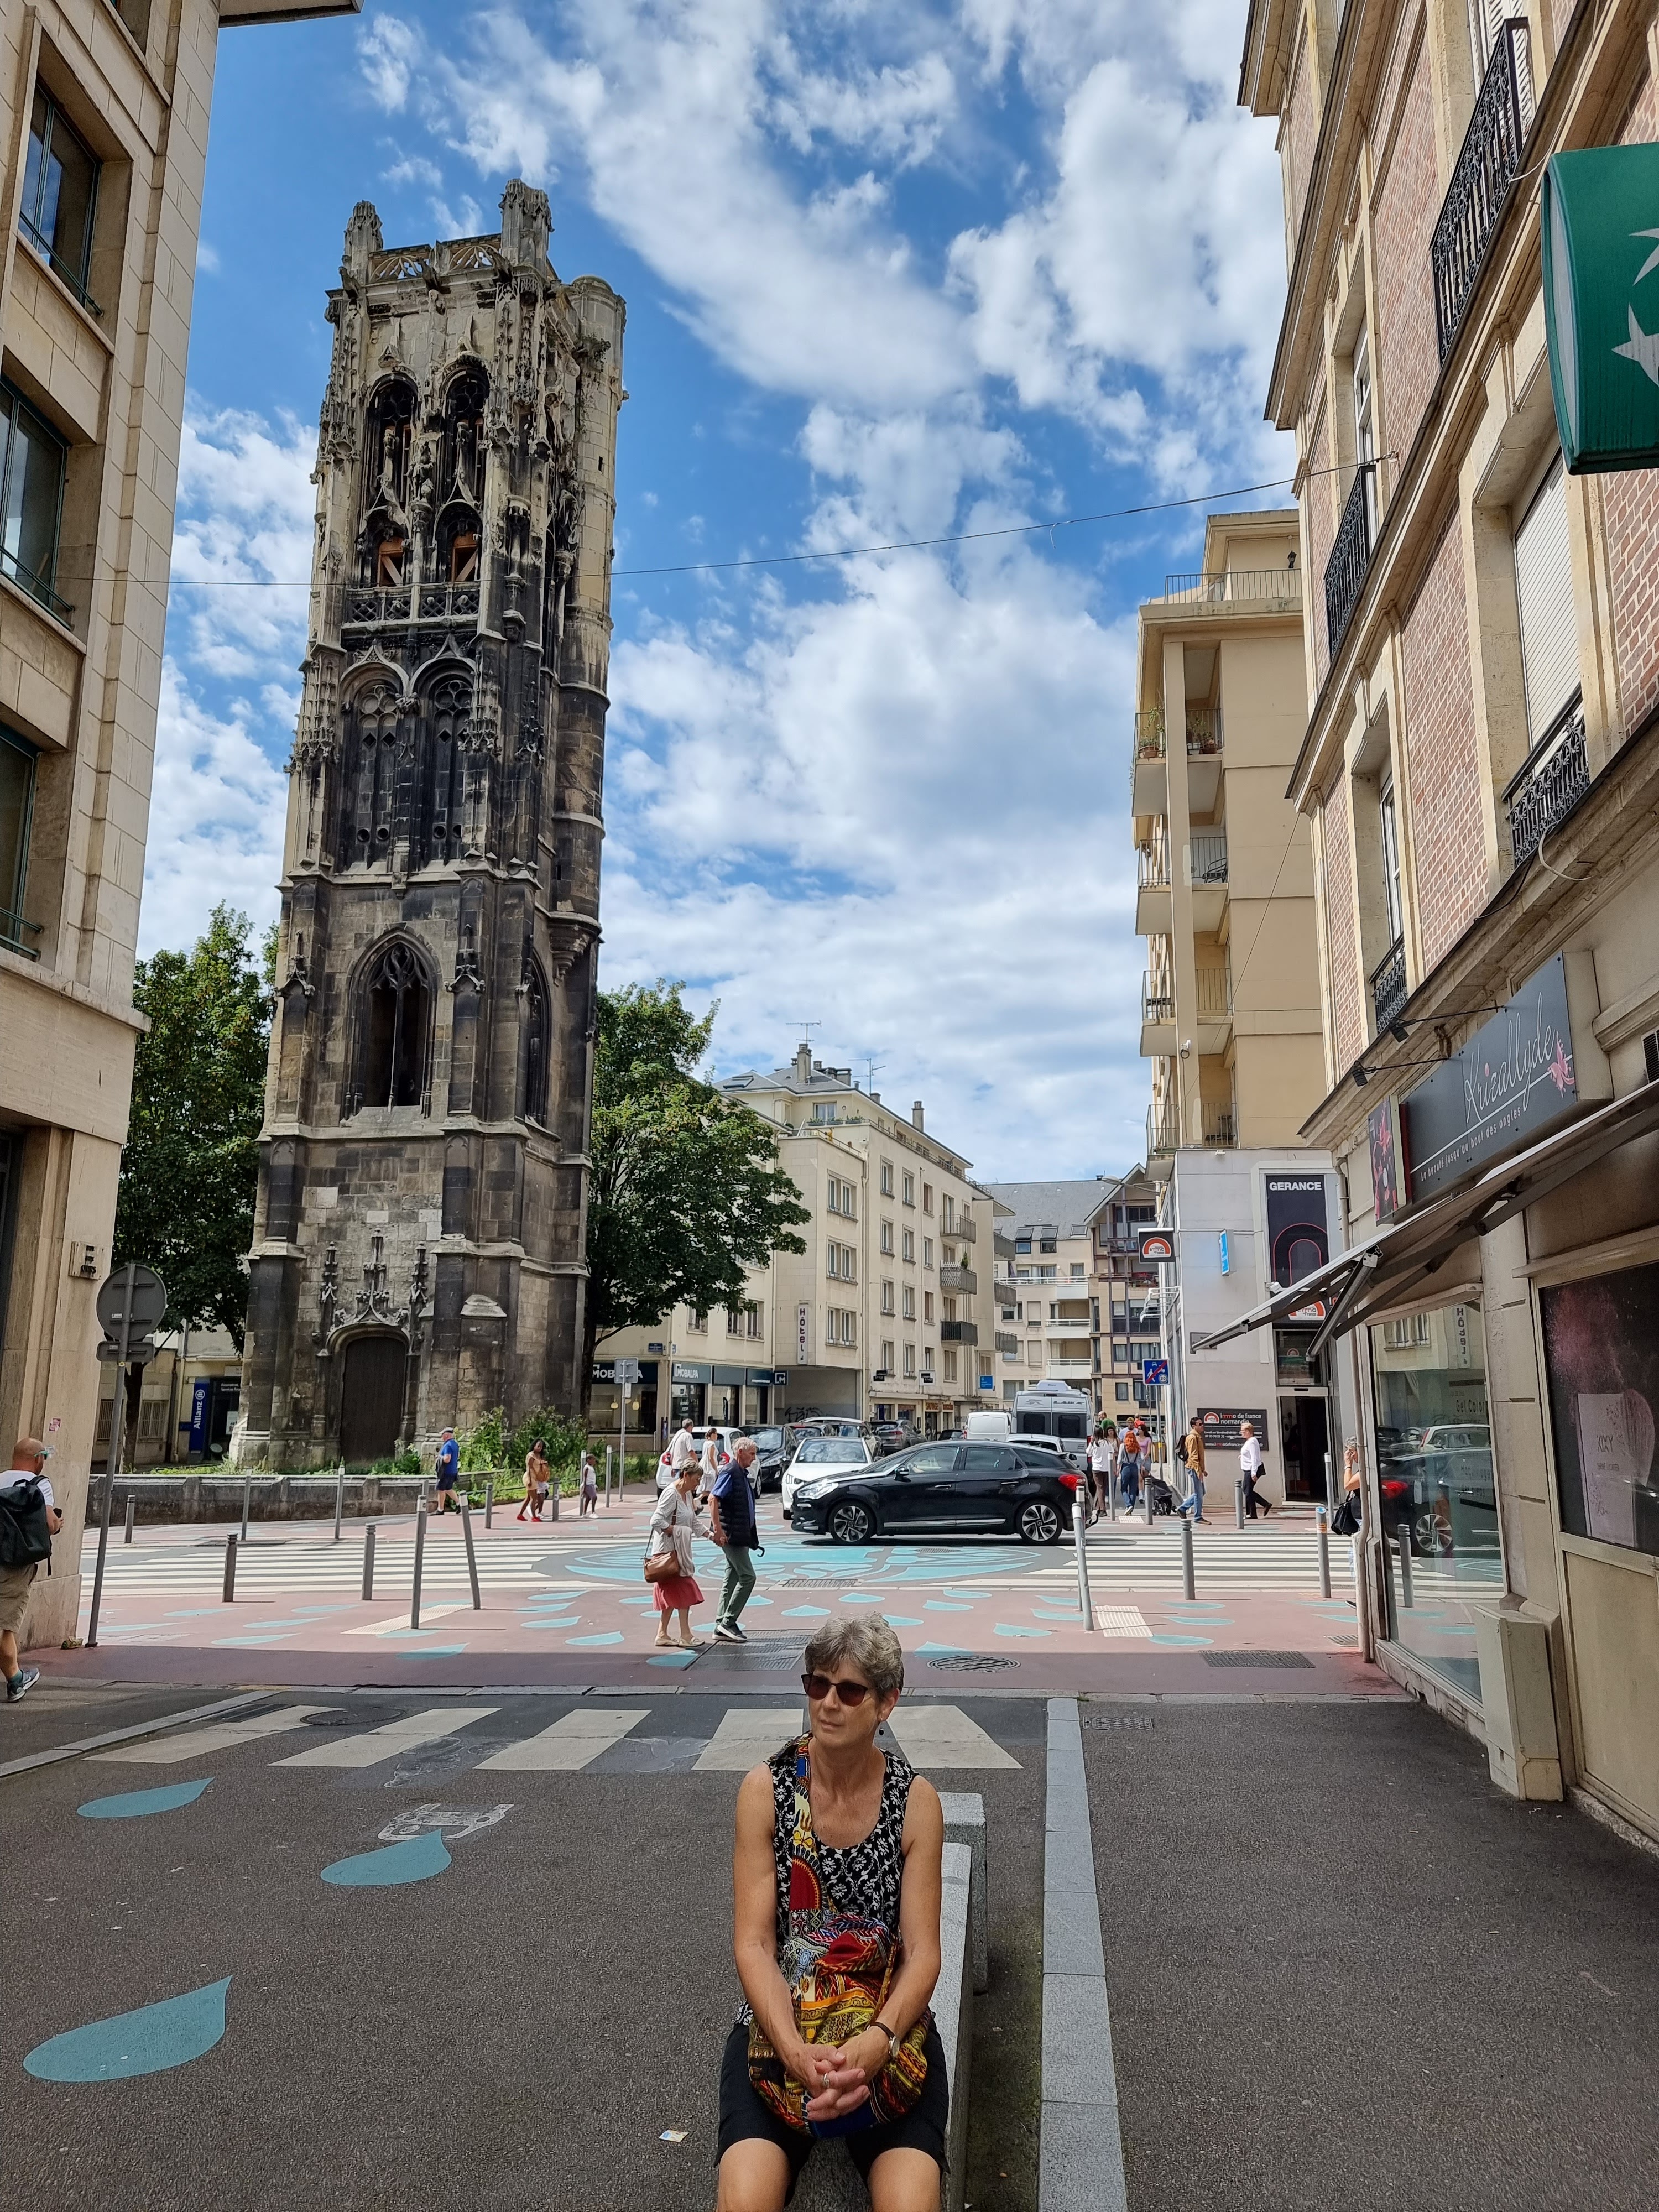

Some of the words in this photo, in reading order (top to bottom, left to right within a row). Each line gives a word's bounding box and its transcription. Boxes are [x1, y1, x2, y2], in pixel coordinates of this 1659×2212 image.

[1420, 1172, 1427, 1182] La
[1428, 1157, 1444, 1177] beauté
[1445, 1142, 1469, 1167] jusqu'au
[1470, 1130, 1484, 1149] bout
[1486, 1123, 1496, 1138] des
[1499, 1107, 1521, 1129] ongles
[1269, 1182, 1322, 1191] GERANCE
[592, 1369, 643, 1378] MOBA
[194, 1401, 203, 1430] Allianz
